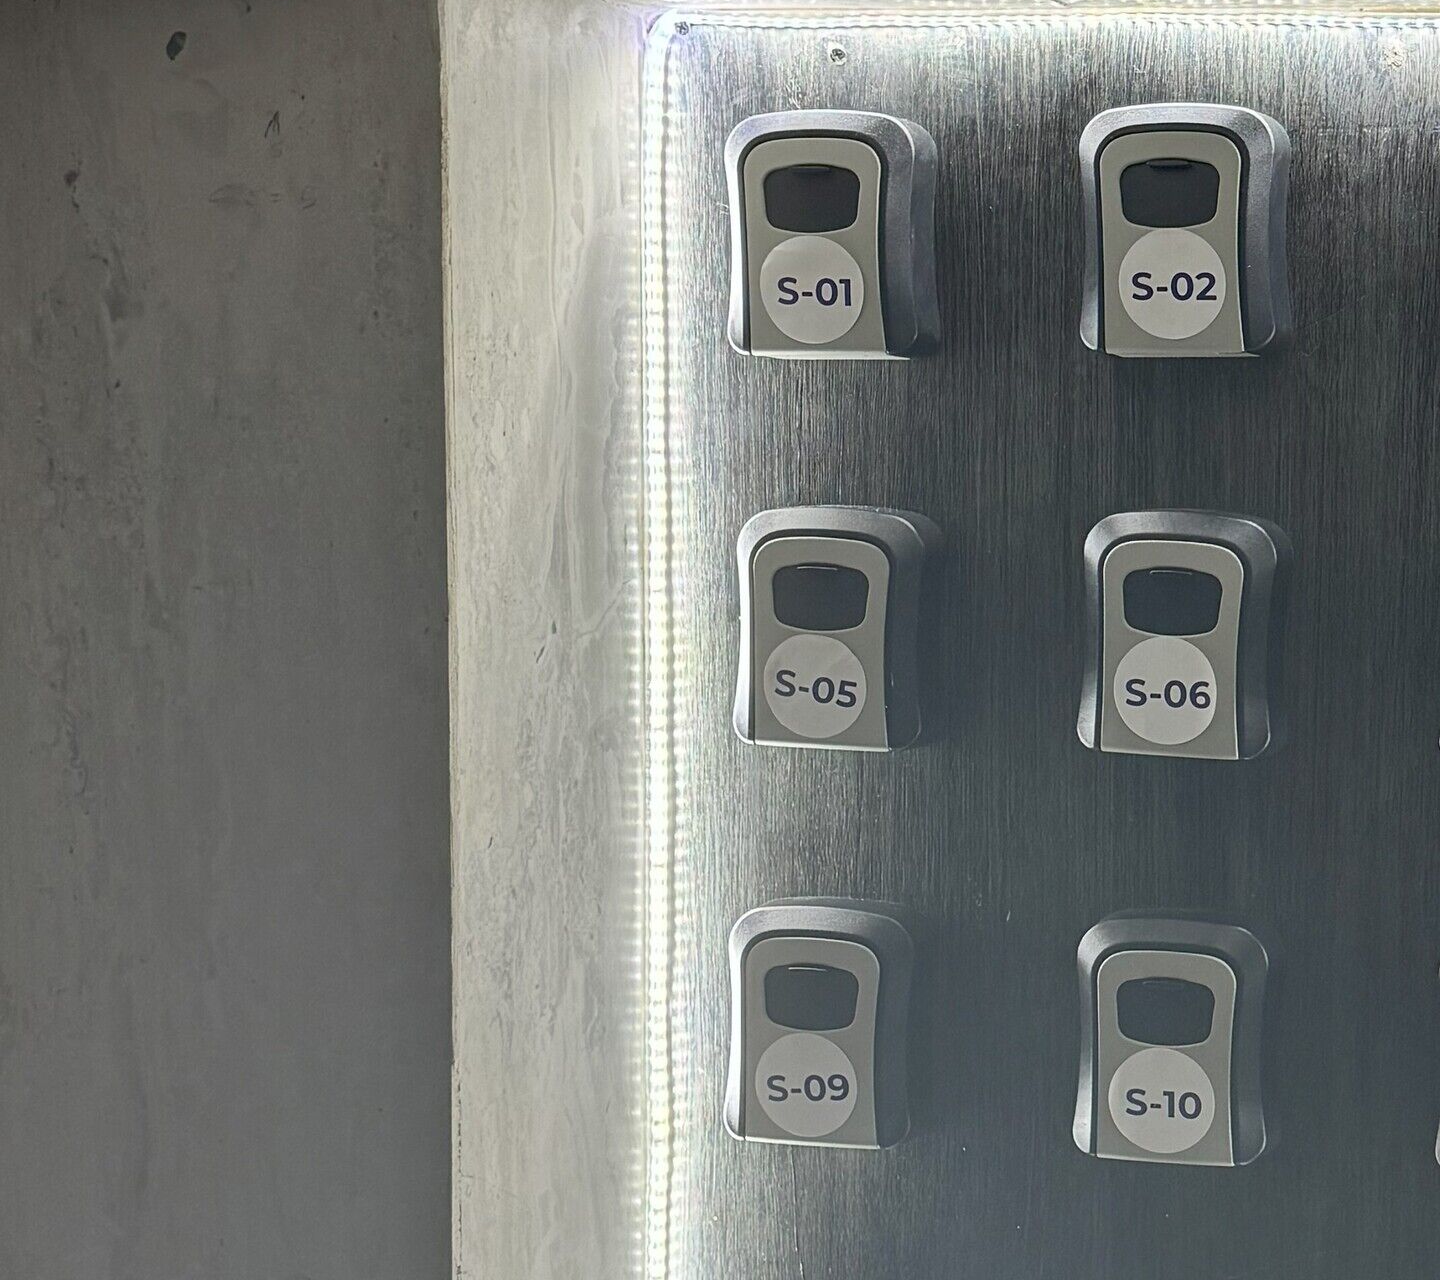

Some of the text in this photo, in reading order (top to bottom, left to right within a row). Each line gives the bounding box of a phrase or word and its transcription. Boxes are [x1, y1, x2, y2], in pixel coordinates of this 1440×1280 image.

[777, 276, 852, 307] S-01
[1131, 271, 1218, 301] S-02
[774, 669, 858, 708] S-05
[1125, 678, 1211, 710] S-06
[766, 1073, 850, 1102] S-09
[1125, 1086, 1203, 1120] S-10
